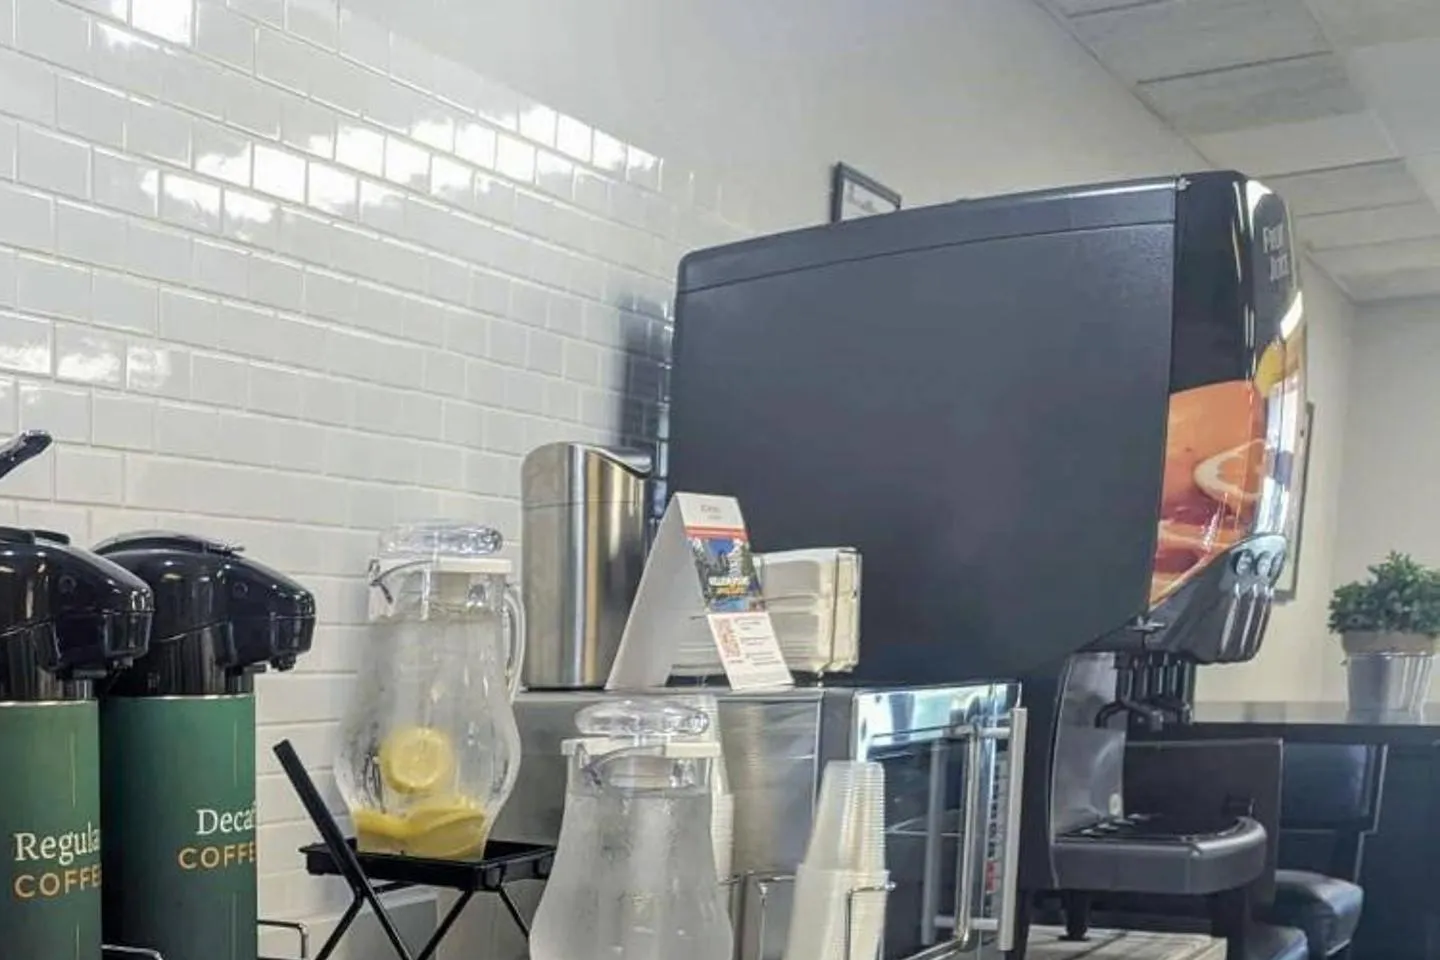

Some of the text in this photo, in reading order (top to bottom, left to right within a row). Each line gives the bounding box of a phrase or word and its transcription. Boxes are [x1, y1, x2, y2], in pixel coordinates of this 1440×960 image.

[196, 808, 255, 836] Deca
[13, 821, 100, 866] Regula
[178, 841, 255, 870] COFFE
[14, 864, 101, 898] COFFE
